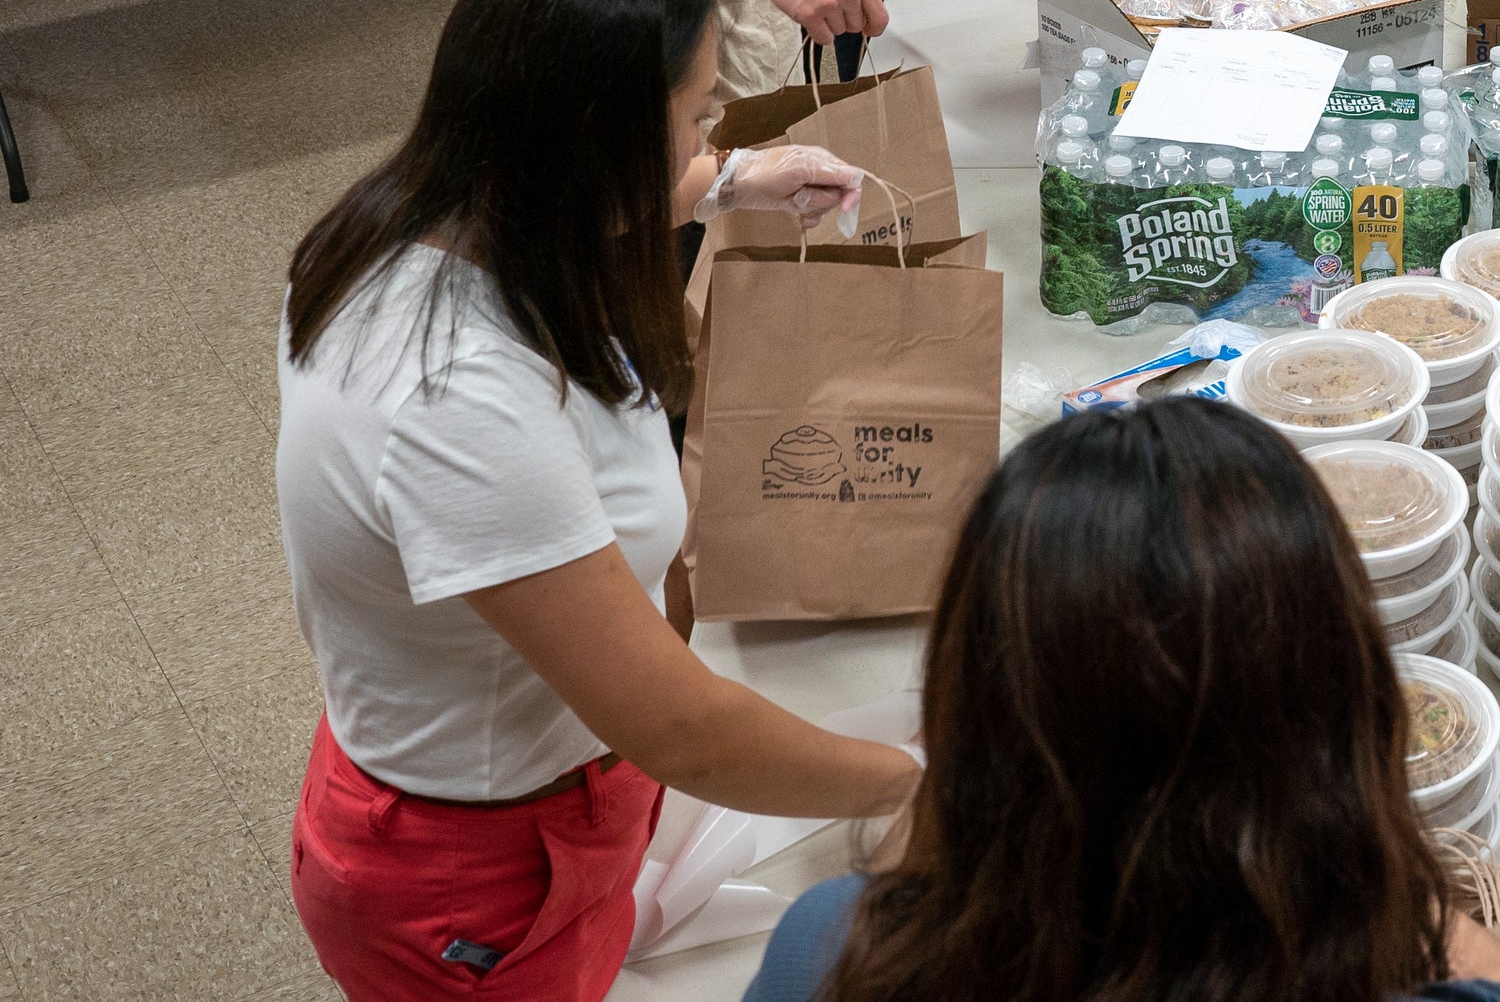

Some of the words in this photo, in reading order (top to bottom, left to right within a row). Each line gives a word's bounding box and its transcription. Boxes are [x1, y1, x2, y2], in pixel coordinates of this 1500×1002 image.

[1356, 23, 1384, 39] 11156
[1327, 95, 1382, 106] Sprin
[1309, 196, 1345, 209] SPRING
[1357, 194, 1398, 219] 40
[1116, 196, 1233, 253] Poland
[1310, 210, 1345, 223] WATER
[861, 215, 913, 245] meals
[1358, 224, 1373, 233] 0.5
[1374, 224, 1397, 234] LITER
[1122, 232, 1239, 283] Spring
[1181, 263, 1207, 277] 1845
[854, 422, 934, 443] meals
[855, 443, 895, 462] for
[763, 490, 837, 501] mealsforunity.org
[867, 491, 933, 501] @mealsforunity
